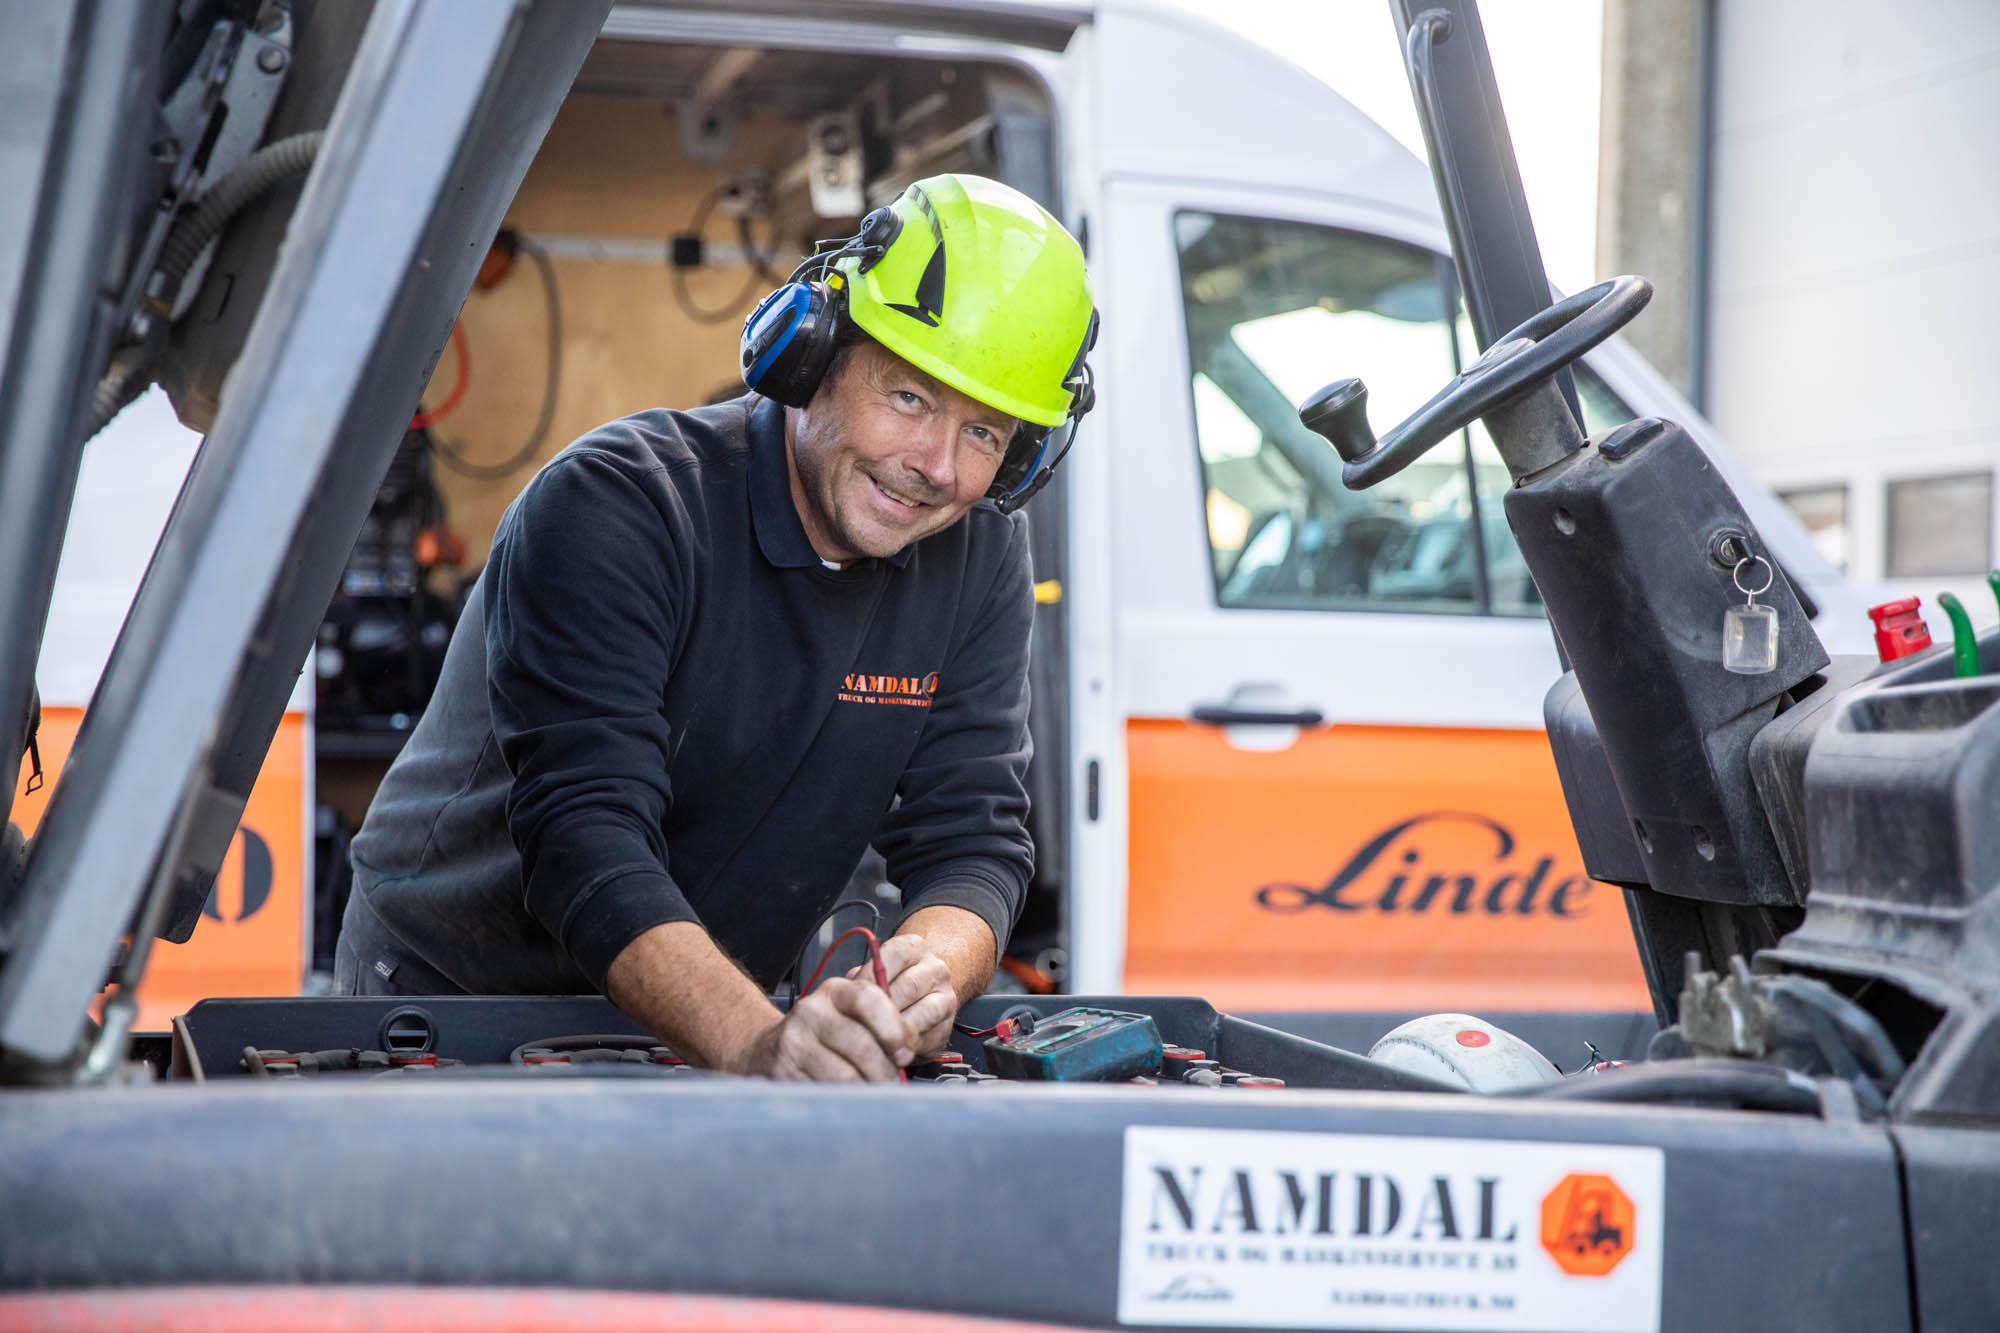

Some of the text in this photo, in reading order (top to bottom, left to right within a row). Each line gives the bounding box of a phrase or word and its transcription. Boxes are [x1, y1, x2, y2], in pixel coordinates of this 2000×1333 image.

[838, 693, 863, 703] TRUCK
[865, 696, 876, 704] OG
[841, 673, 923, 695] NAMDAL
[1256, 811, 1592, 917] Linde
[1148, 1164, 1518, 1243] NAMDAL
